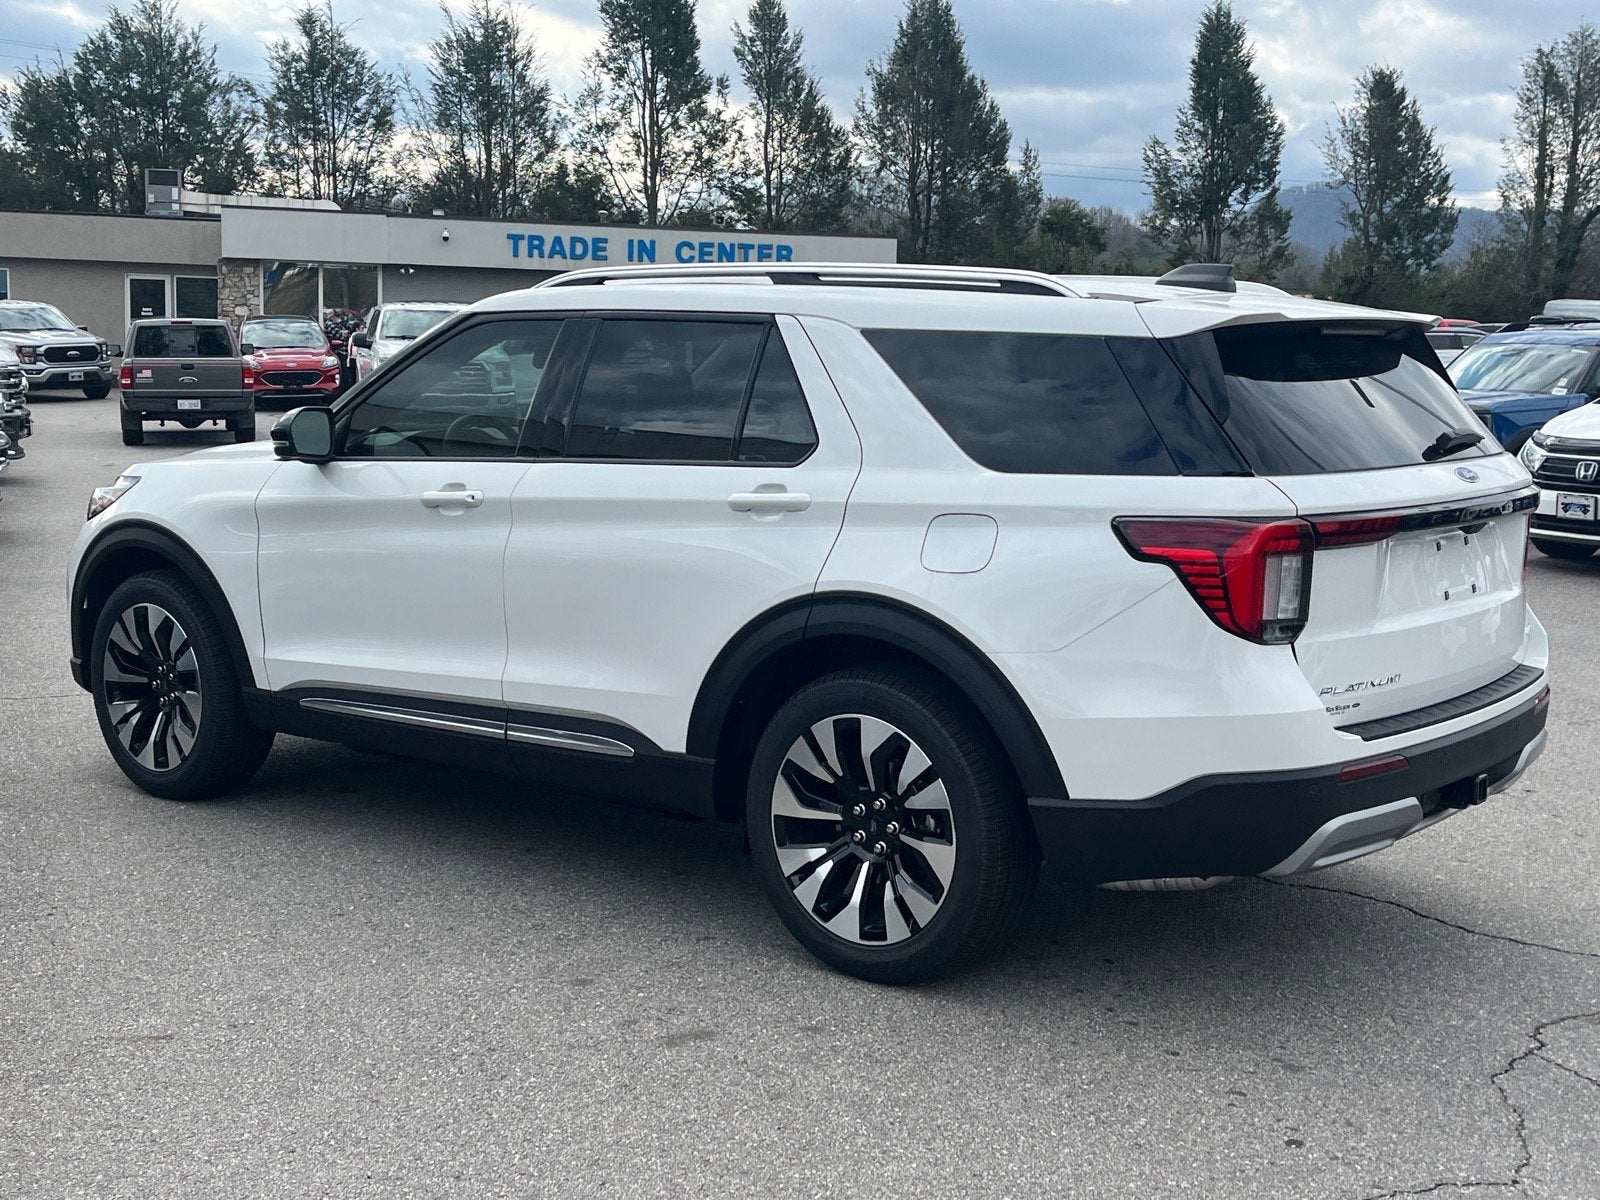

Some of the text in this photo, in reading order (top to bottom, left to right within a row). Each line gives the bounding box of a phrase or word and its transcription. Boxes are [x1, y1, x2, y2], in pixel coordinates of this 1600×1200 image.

[506, 234, 793, 263] TRADE IN CENTER
[1318, 673, 1401, 697] PLATINUM
